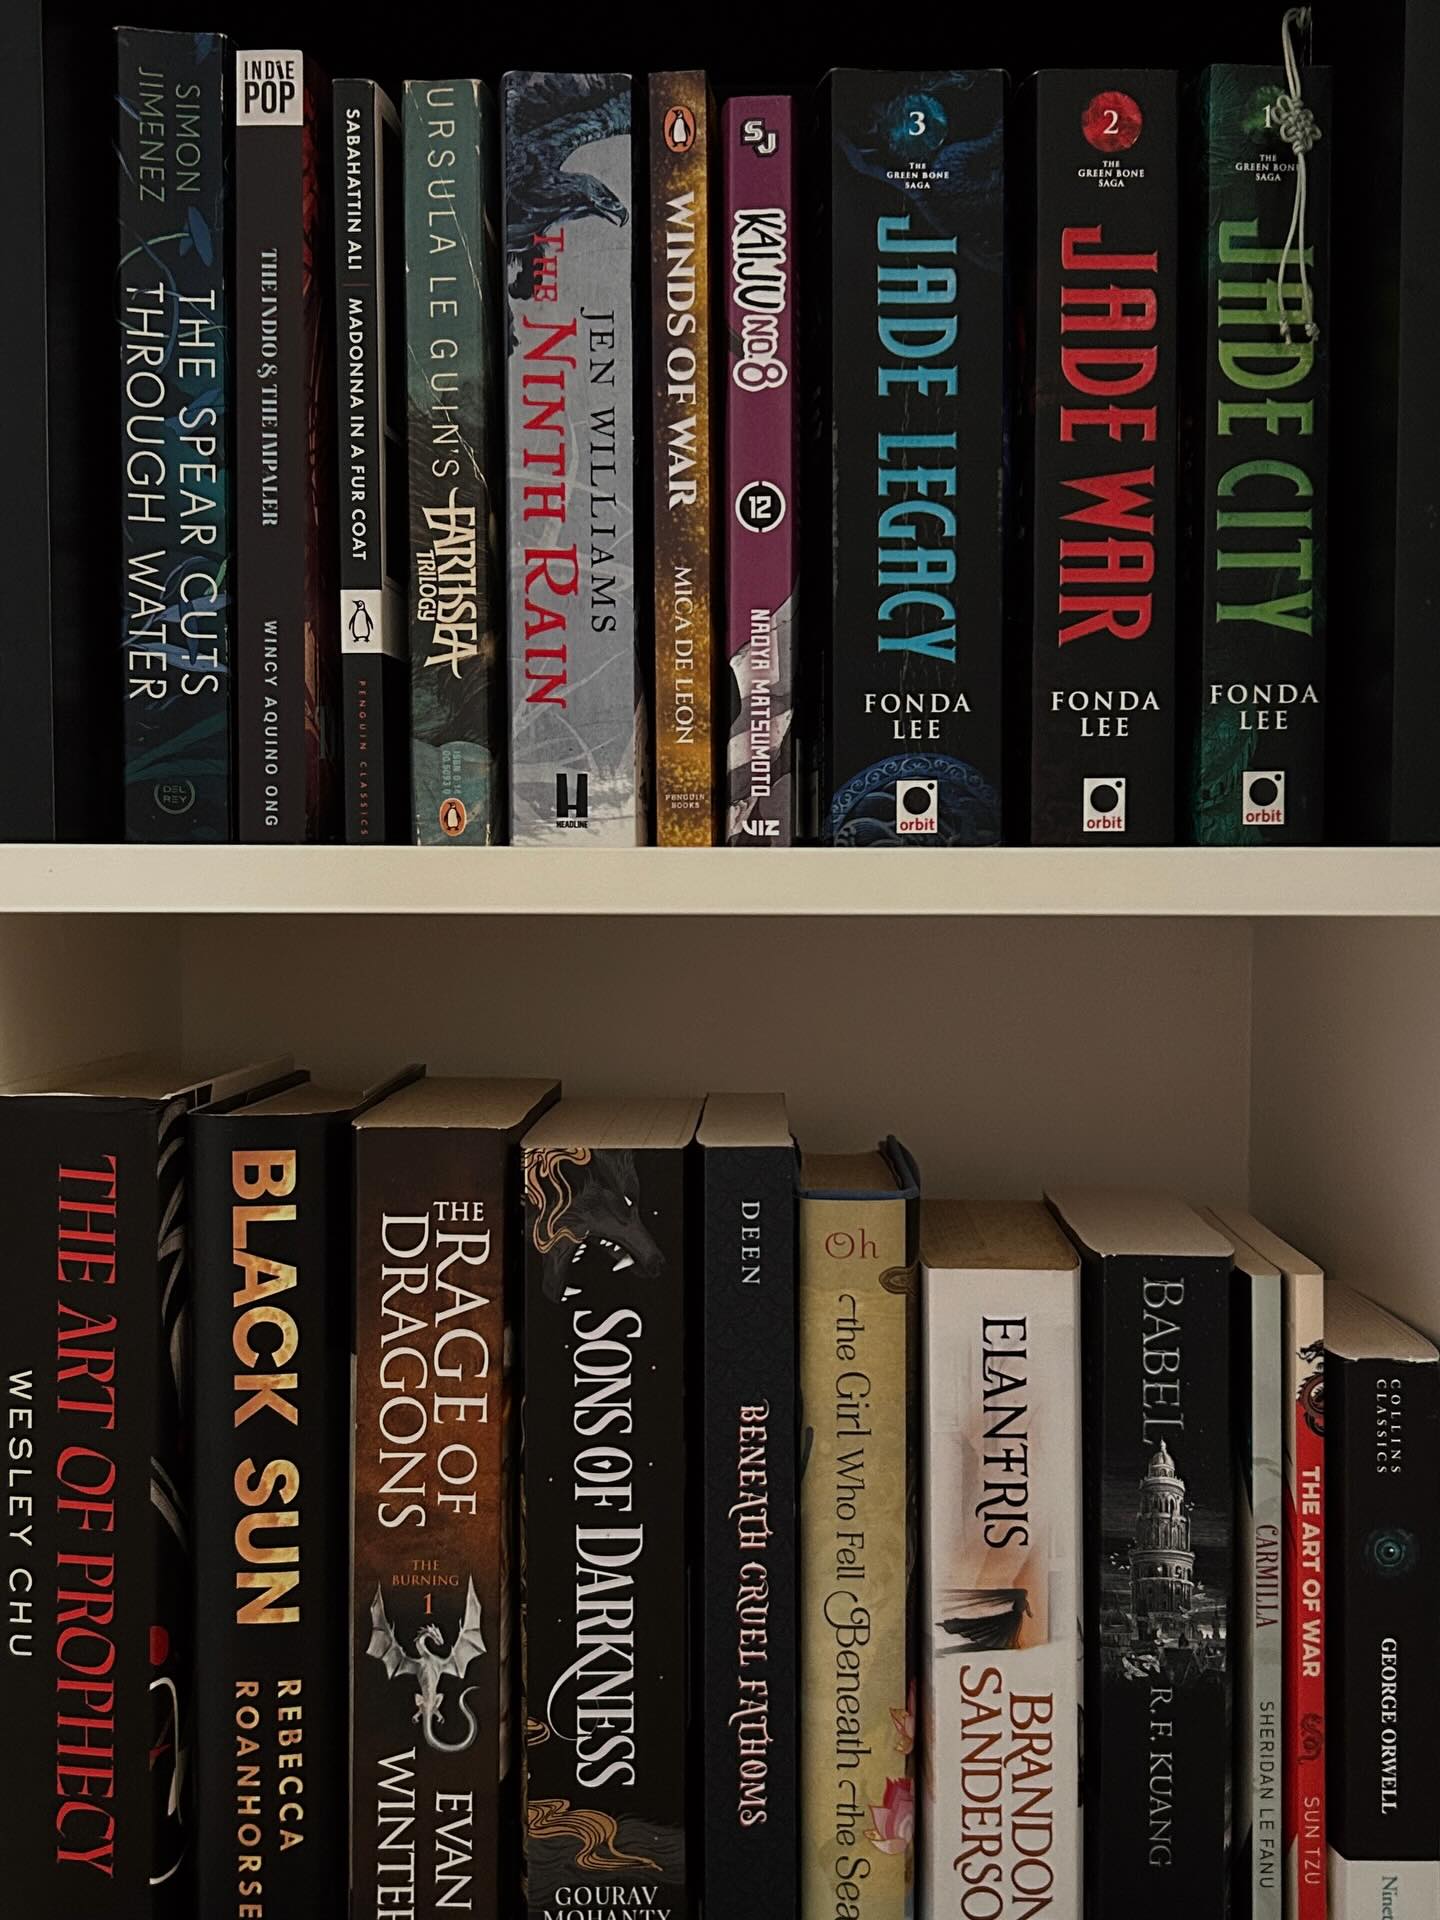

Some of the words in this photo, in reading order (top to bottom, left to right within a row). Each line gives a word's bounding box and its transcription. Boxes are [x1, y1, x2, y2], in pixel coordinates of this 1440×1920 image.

[243, 80, 295, 114] POP
[244, 59, 295, 79] INDIE
[138, 65, 165, 203] JIMENEZ
[175, 83, 201, 192] SIMON
[908, 110, 927, 136] 3
[1102, 110, 1120, 135] 2
[1263, 104, 1273, 129] 1
[345, 107, 361, 233] SABAHATTIN
[427, 86, 457, 255] URSULA
[886, 172, 918, 181] GREEN
[922, 172, 950, 181] BONE
[905, 181, 931, 191] SAGA
[908, 163, 926, 171] THE
[1078, 168, 1113, 178] GREEN
[1117, 168, 1145, 179] BONE
[1098, 177, 1125, 188] SAGA
[1102, 159, 1121, 168] THE
[1235, 163, 1270, 173] GREEN
[1273, 163, 1300, 173] BON
[1255, 172, 1282, 182] SAGA
[1259, 153, 1277, 163] THE
[261, 248, 279, 289] THE
[347, 238, 362, 270] ALI
[533, 228, 565, 302] THE
[666, 191, 697, 337] WINDS
[736, 211, 783, 310] KAIJU
[179, 290, 216, 379] THE
[261, 297, 278, 358] INDIO
[430, 276, 458, 319] LE
[876, 213, 960, 398] JADE
[1059, 224, 1160, 443] JADE
[1217, 217, 1316, 437] JADE
[347, 297, 365, 410] MADONNA
[580, 306, 615, 387] JEN
[667, 346, 697, 405] OF
[126, 282, 165, 523] THROUGH
[261, 384, 279, 422] THE
[350, 415, 365, 437] IN
[430, 339, 460, 477] GUIN'S
[522, 316, 578, 524] NINTH
[179, 405, 217, 545] SPEAR
[261, 430, 280, 527] IMPALER
[350, 444, 366, 459] A
[350, 466, 366, 502] FUR
[667, 415, 698, 512] WAR
[350, 509, 367, 560] COAT
[589, 406, 617, 633] WILLIAMS
[748, 494, 773, 520] 12
[421, 486, 483, 680] EARTHSEA
[877, 431, 959, 665] LEGACY
[1057, 463, 1158, 649] WAR
[1215, 458, 1314, 640] CITY
[415, 548, 441, 623] TRILOGY
[673, 565, 693, 633] MICA
[128, 550, 167, 700] WATER
[180, 572, 219, 696] CUTS
[263, 621, 279, 686] WINCY
[524, 544, 579, 709] RAIN
[673, 637, 694, 671] DE
[750, 608, 772, 671] NAOYA
[358, 680, 367, 753] PENGUIN
[673, 675, 695, 746] LEON
[863, 691, 973, 715] FONDA
[893, 717, 942, 741] LEE
[1050, 689, 1161, 712] FONDA
[1080, 716, 1130, 738] LEE
[1209, 683, 1321, 706] FONDA
[1239, 709, 1290, 732] LEE
[263, 696, 280, 776] AQUINO
[750, 680, 772, 798] MATSUMOTO
[263, 784, 280, 827] ONG
[359, 762, 369, 836] CLASSICS
[556, 773, 588, 818] H
[556, 820, 588, 829] HEADLINE
[665, 793, 705, 801] PENGUIN
[671, 801, 700, 809] BOOKS
[899, 817, 936, 831] orbit
[1085, 815, 1124, 829] orbit
[1245, 808, 1283, 822] orbit
[57, 1153, 119, 1285] THE
[434, 1200, 485, 1223] THE
[740, 1199, 761, 1286] DEEN
[825, 1228, 880, 1260] Oh
[231, 1147, 300, 1429] BLACK
[433, 1228, 492, 1426] RAGE
[1142, 1276, 1185, 1446] BABEL
[57, 1299, 119, 1432] ART
[379, 1211, 431, 1529] DRAGONS
[572, 1307, 644, 1437] SONS
[836, 1372, 872, 1439] Girl
[975, 1315, 1030, 1550] ELANTRIS
[1376, 1379, 1389, 1475] CLASSICS
[1390, 1379, 1403, 1475] COLLINS
[8, 1368, 34, 1547] WESLEY
[57, 1445, 118, 1533] OF
[436, 1442, 479, 1516] OF
[573, 1445, 635, 1513] OF
[727, 1398, 776, 1552] BENEATH
[836, 1447, 866, 1521] Who
[1301, 1463, 1322, 1515] THE
[233, 1455, 301, 1626] SUN
[410, 1559, 441, 1573] THE
[836, 1531, 866, 1581] Fell
[1255, 1524, 1280, 1630] CARMILLA
[1301, 1522, 1321, 1573] ART
[8, 1567, 34, 1658] CHU
[391, 1573, 461, 1587] BURNING
[424, 1592, 434, 1616] 1
[736, 1559, 772, 1668] CRUEL
[1301, 1579, 1321, 1615] OF
[546, 1521, 646, 1790] DARKNESS
[824, 1590, 873, 1771] Beneath
[1301, 1621, 1322, 1680] WAR
[1380, 1636, 1399, 1723] GEORGE
[56, 1551, 118, 1880] PROPHECY
[727, 1674, 775, 1830] FATHOMS
[1259, 1700, 1276, 1801] SHERIDAN
[235, 1679, 265, 1920] ROANHORSE
[276, 1679, 305, 1853] REBECCA
[1380, 1728, 1399, 1816] ORWELL
[1003, 1690, 1055, 1920] BRANDON
[1148, 1750, 1176, 1870] KUANG
[1259, 1807, 1276, 1828] LE
[1303, 1796, 1321, 1836] SUN
[434, 1790, 473, 1912] EVAN
[1259, 1833, 1277, 1889] FANU
[1303, 1841, 1322, 1886] TZU
[554, 1885, 659, 1907] GOURAV
